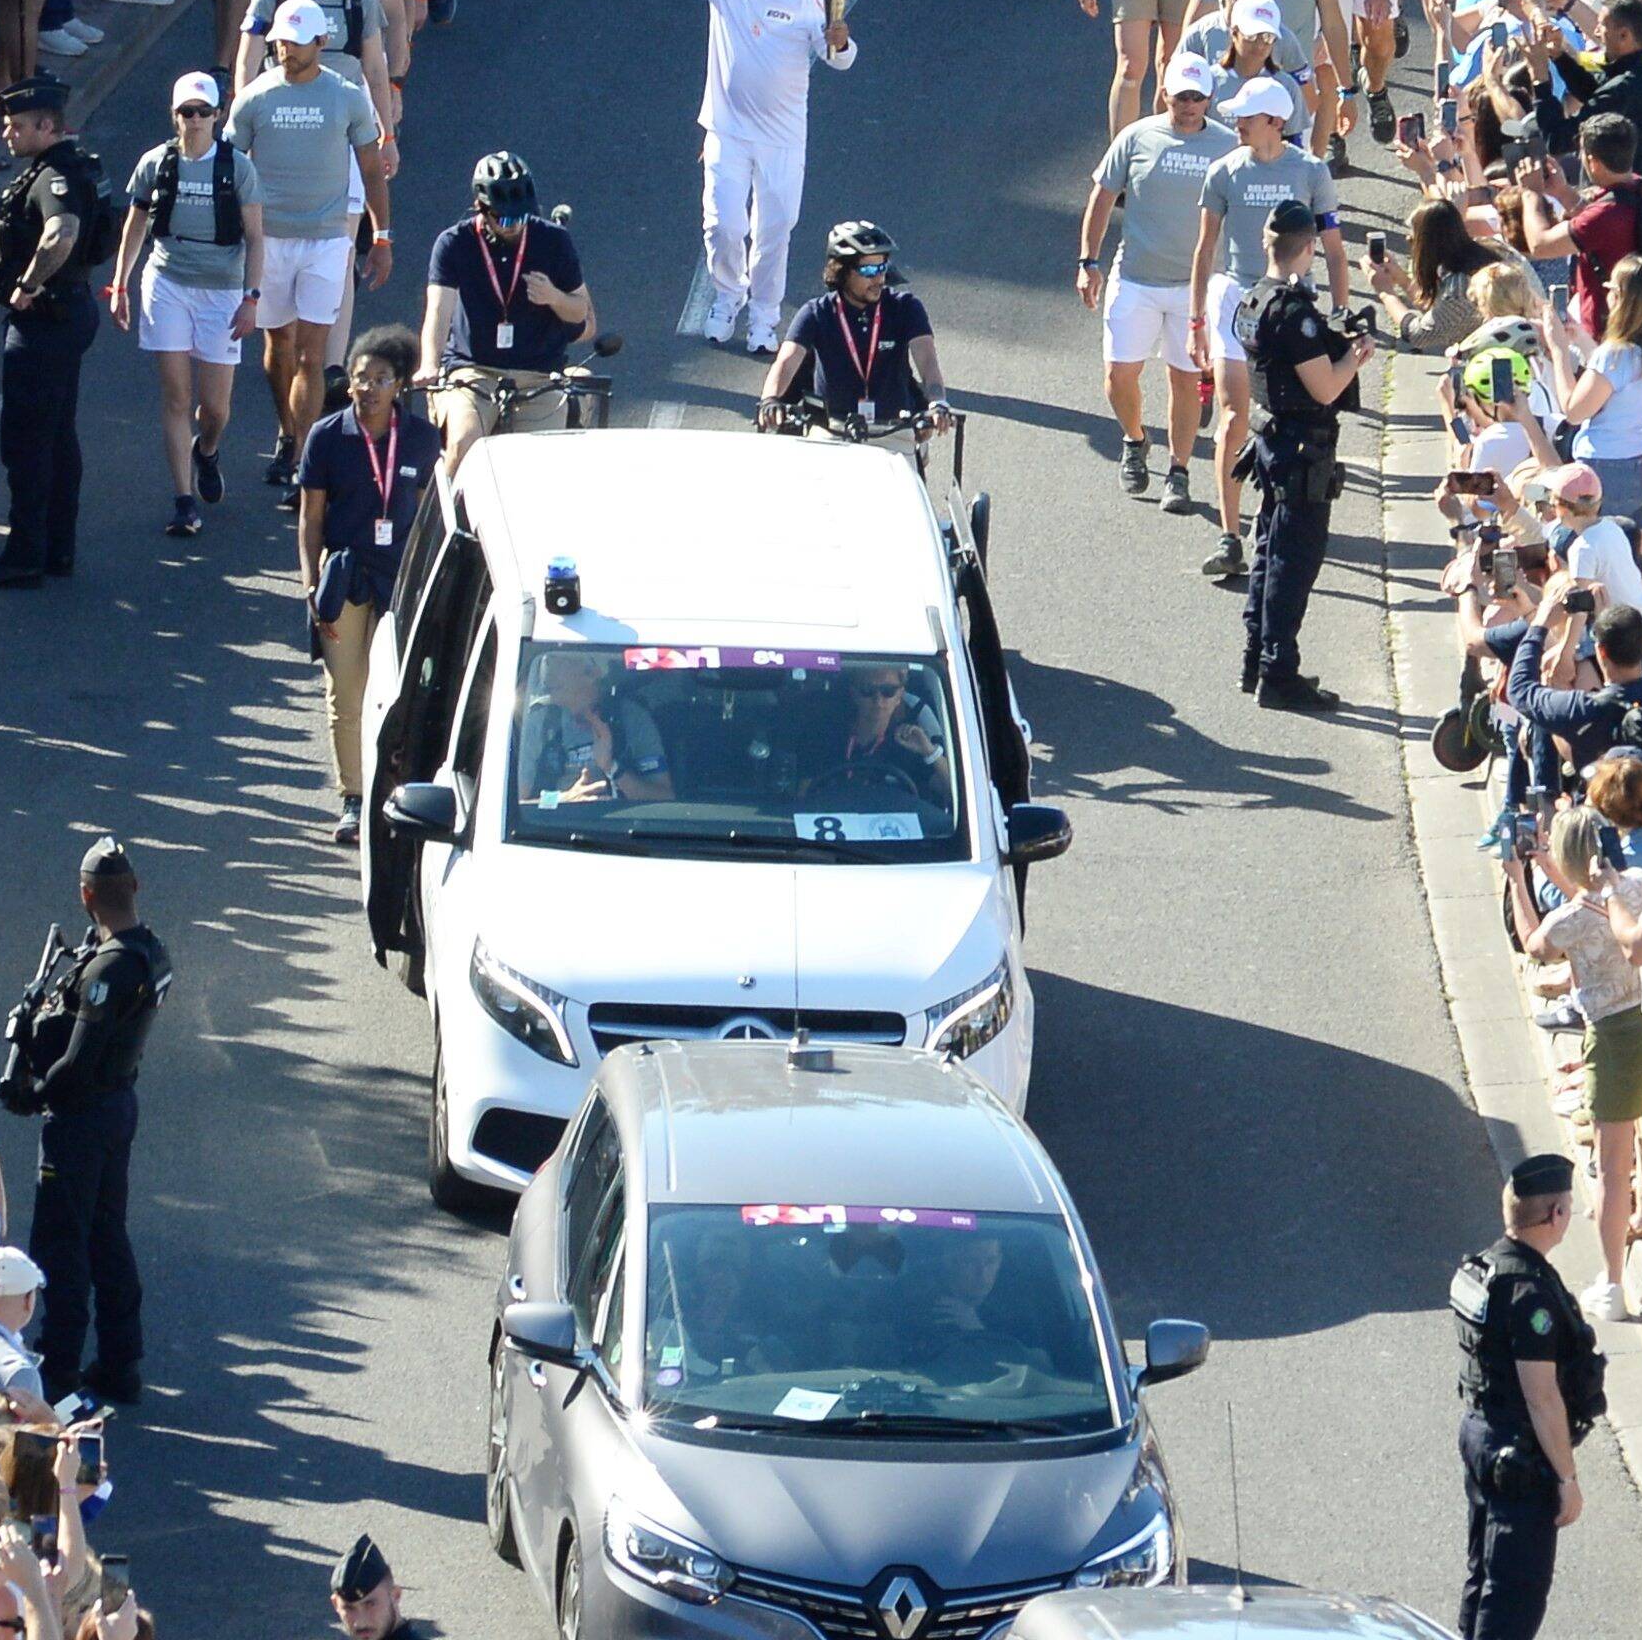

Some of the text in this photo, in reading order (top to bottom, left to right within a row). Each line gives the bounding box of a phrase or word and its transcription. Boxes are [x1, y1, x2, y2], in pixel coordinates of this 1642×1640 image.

[276, 106, 321, 116] RELAIS DE
[283, 114, 325, 124] FLAMME
[1174, 160, 1208, 172] FLAMM
[1247, 184, 1291, 193] RELAIS DE
[752, 650, 785, 666] 84
[814, 816, 847, 841] 8
